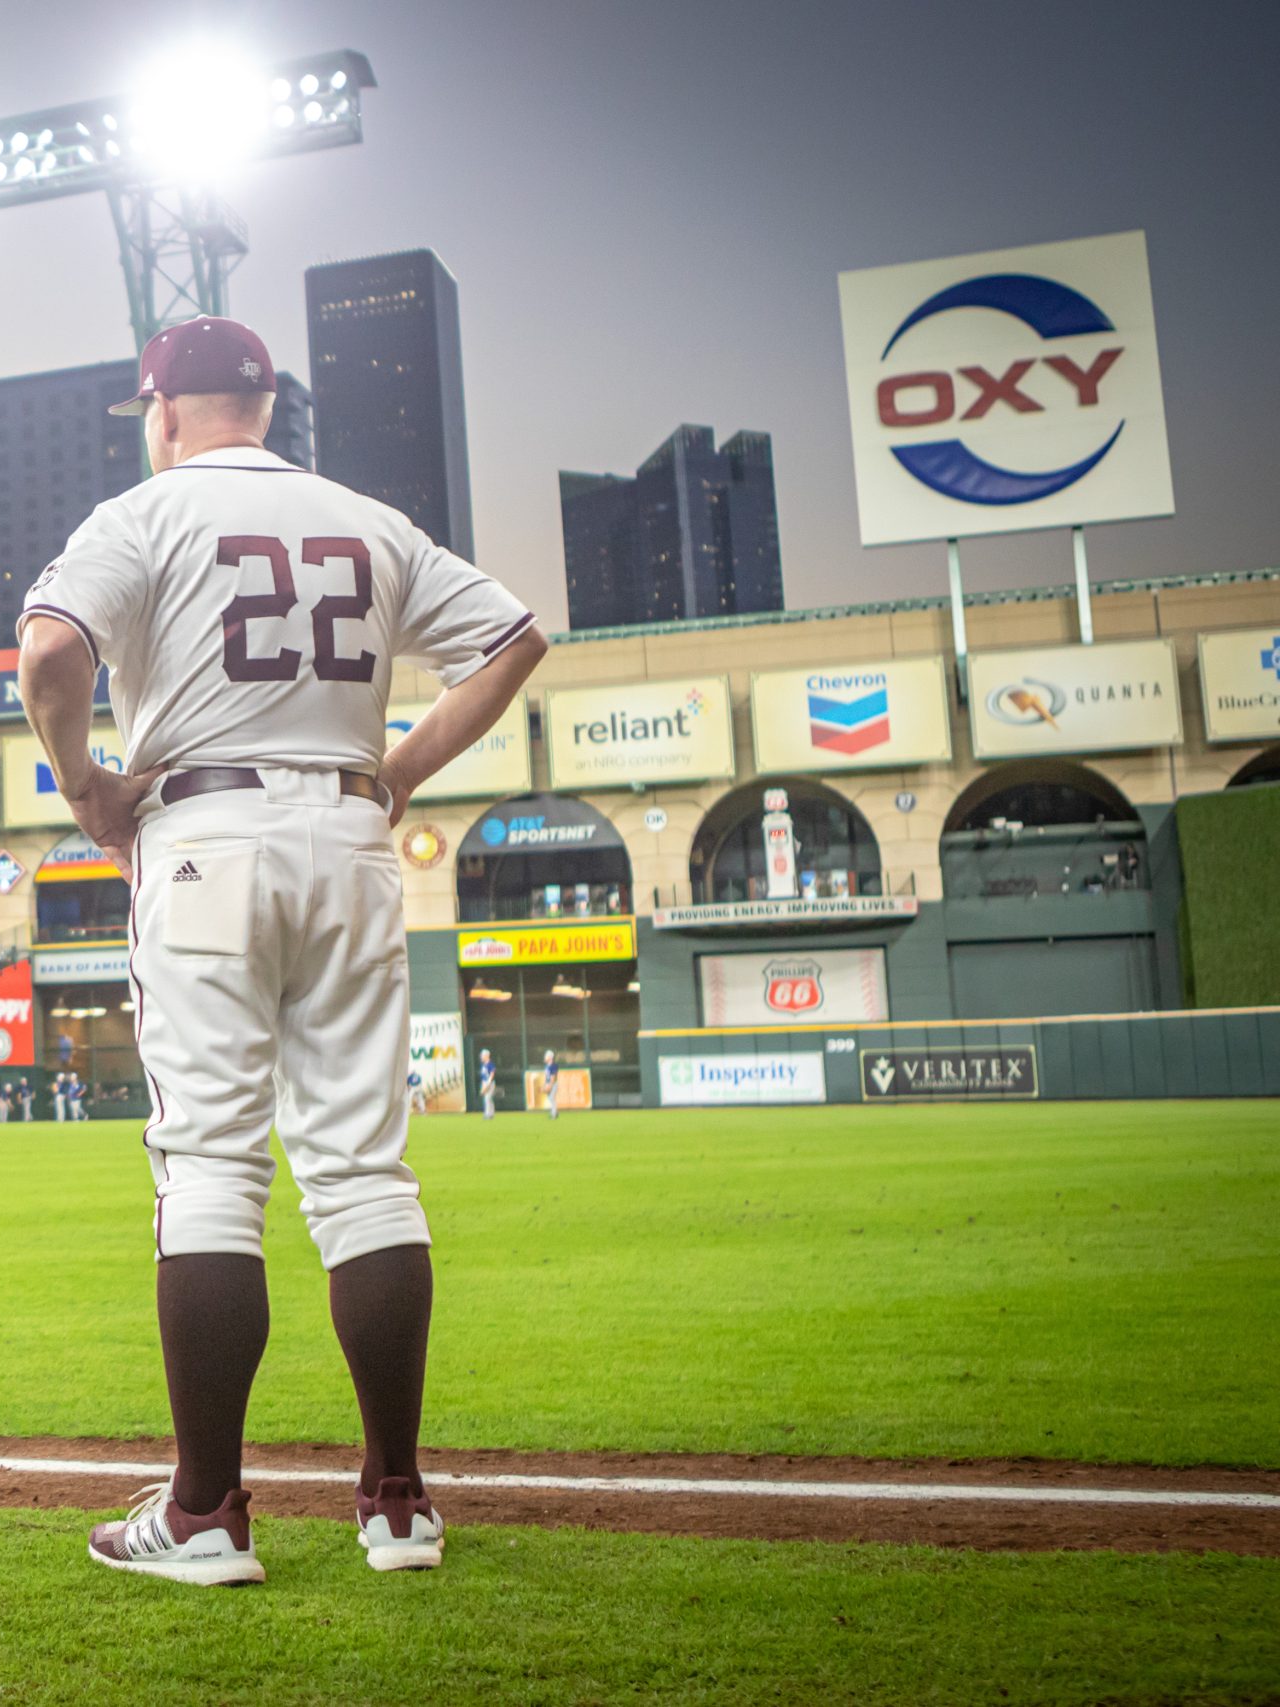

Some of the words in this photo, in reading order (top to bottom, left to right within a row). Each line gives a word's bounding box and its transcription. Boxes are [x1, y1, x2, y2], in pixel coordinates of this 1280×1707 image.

[875, 346, 1126, 428] OXY
[215, 535, 377, 683] 22
[807, 673, 887, 690] Chevron
[1075, 682, 1163, 704] QUANTA
[1218, 692, 1280, 711] BlueCr
[574, 708, 691, 745] reliant
[509, 825, 596, 844] SPORTSNET
[54, 846, 105, 862] Crawfo
[172, 873, 202, 882] adidas
[670, 908, 730, 921] PROVIDING
[734, 904, 784, 917] ENERGY.
[787, 901, 857, 914] IMPROVING
[518, 937, 558, 956] PAPA
[563, 934, 624, 954] JOHN'S
[40, 963, 72, 974] BANK
[75, 962, 90, 973] OF
[94, 961, 127, 971] AMER
[774, 981, 812, 1006] 66
[410, 1045, 457, 1061] WM
[699, 1060, 799, 1086] Insperity
[903, 1058, 1024, 1081] VERITEX
